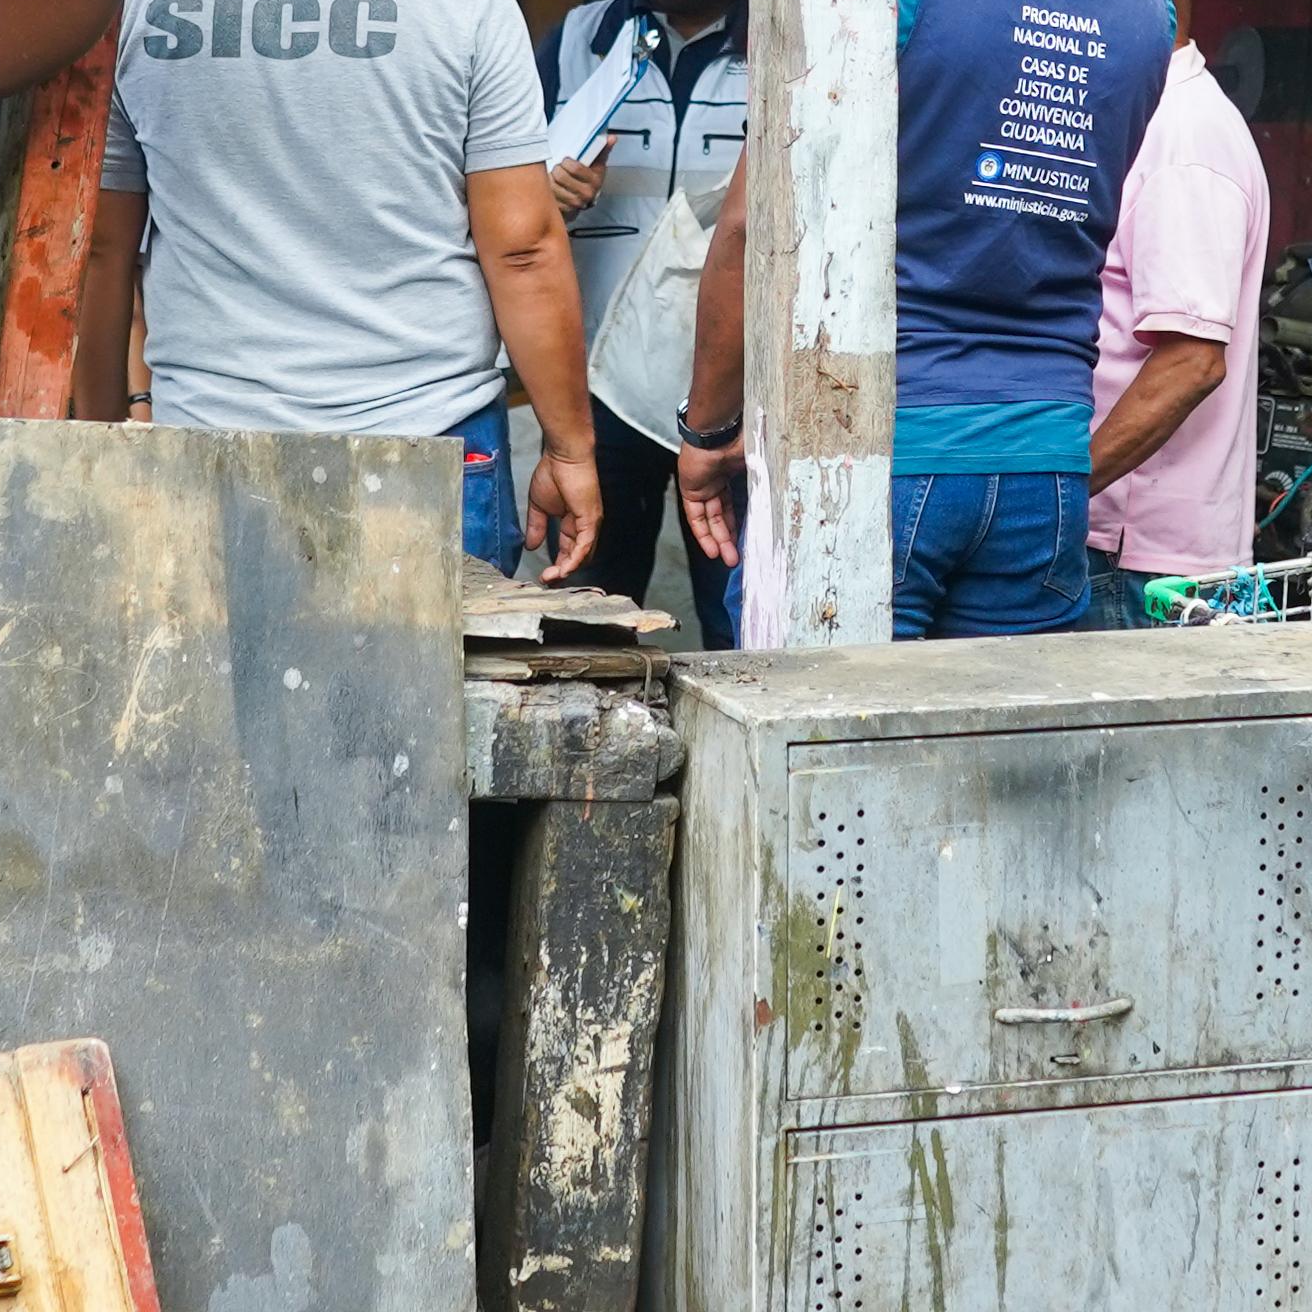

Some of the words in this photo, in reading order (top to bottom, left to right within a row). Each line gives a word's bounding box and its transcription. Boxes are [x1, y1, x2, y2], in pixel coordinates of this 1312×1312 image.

[1022, 5, 1101, 36] PROGRAMA
[1013, 27, 1083, 56] NACIONAL
[1087, 40, 1107, 59] DE
[1021, 56, 1065, 80] CASAS
[1068, 66, 1089, 84] DE
[1015, 78, 1074, 103] JUSTICIA
[1077, 90, 1088, 106] Y
[999, 98, 1093, 131] CONVIVENCIA
[1000, 121, 1085, 152] CIUDADANA
[1002, 162, 1090, 192] MINJUSTICIA
